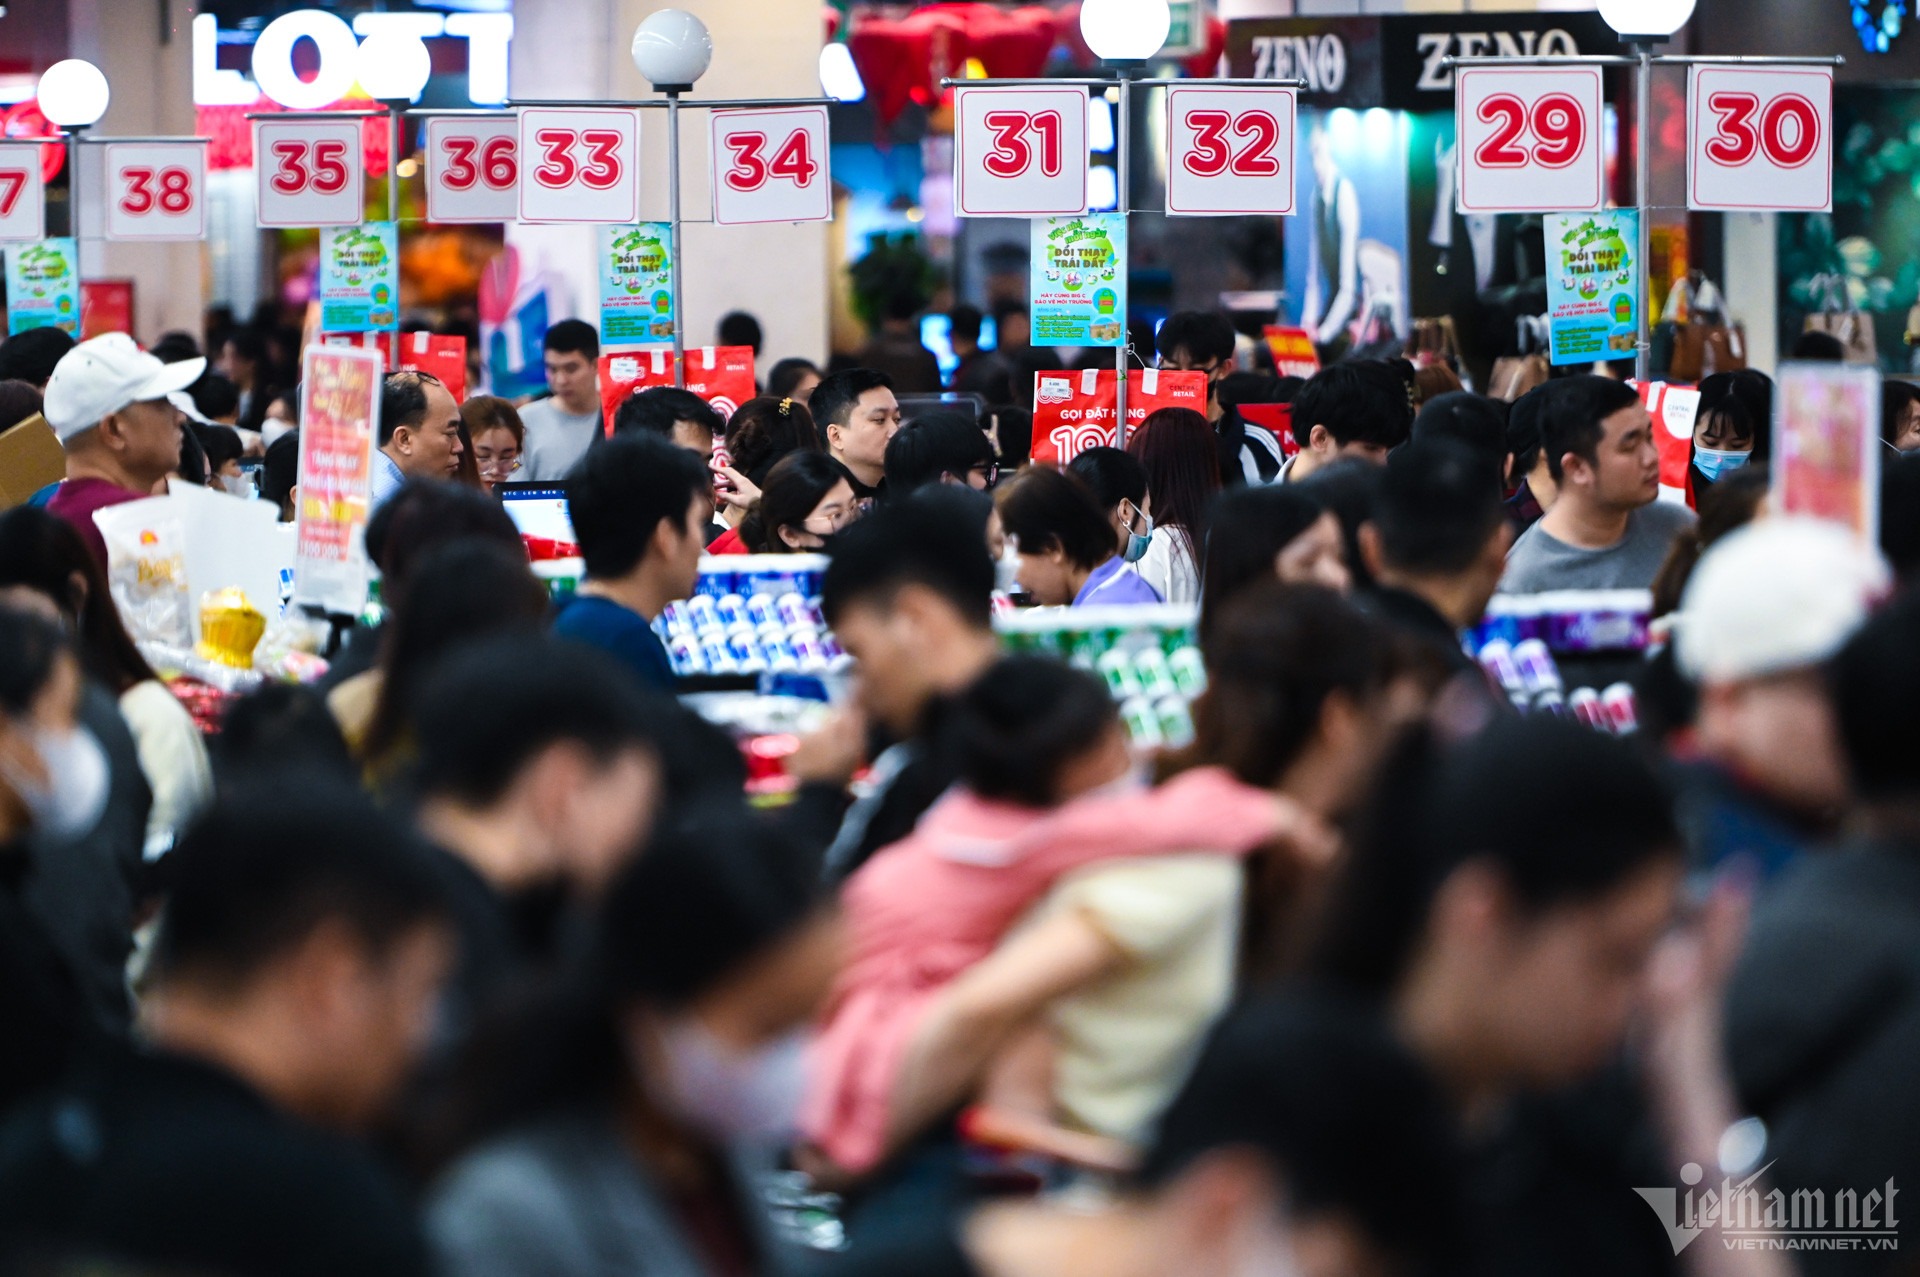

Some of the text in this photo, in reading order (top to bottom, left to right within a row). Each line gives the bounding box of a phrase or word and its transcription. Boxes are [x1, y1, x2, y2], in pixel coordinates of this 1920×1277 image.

[1252, 34, 1346, 93] ZENO
[533, 128, 624, 190] 33
[724, 127, 818, 192] 34
[982, 109, 1062, 178] 31
[1183, 110, 1280, 178] 32
[1474, 92, 1586, 169] 29
[1705, 91, 1821, 169] 30
[118, 164, 193, 218] 38
[269, 139, 349, 195] 35
[439, 134, 517, 195] 36
[1054, 257, 1079, 268] TRÁI
[1077, 248, 1107, 257] THAY
[1591, 249, 1620, 260] THAY
[1060, 406, 1145, 421] GỌI ĐẶT HNG
